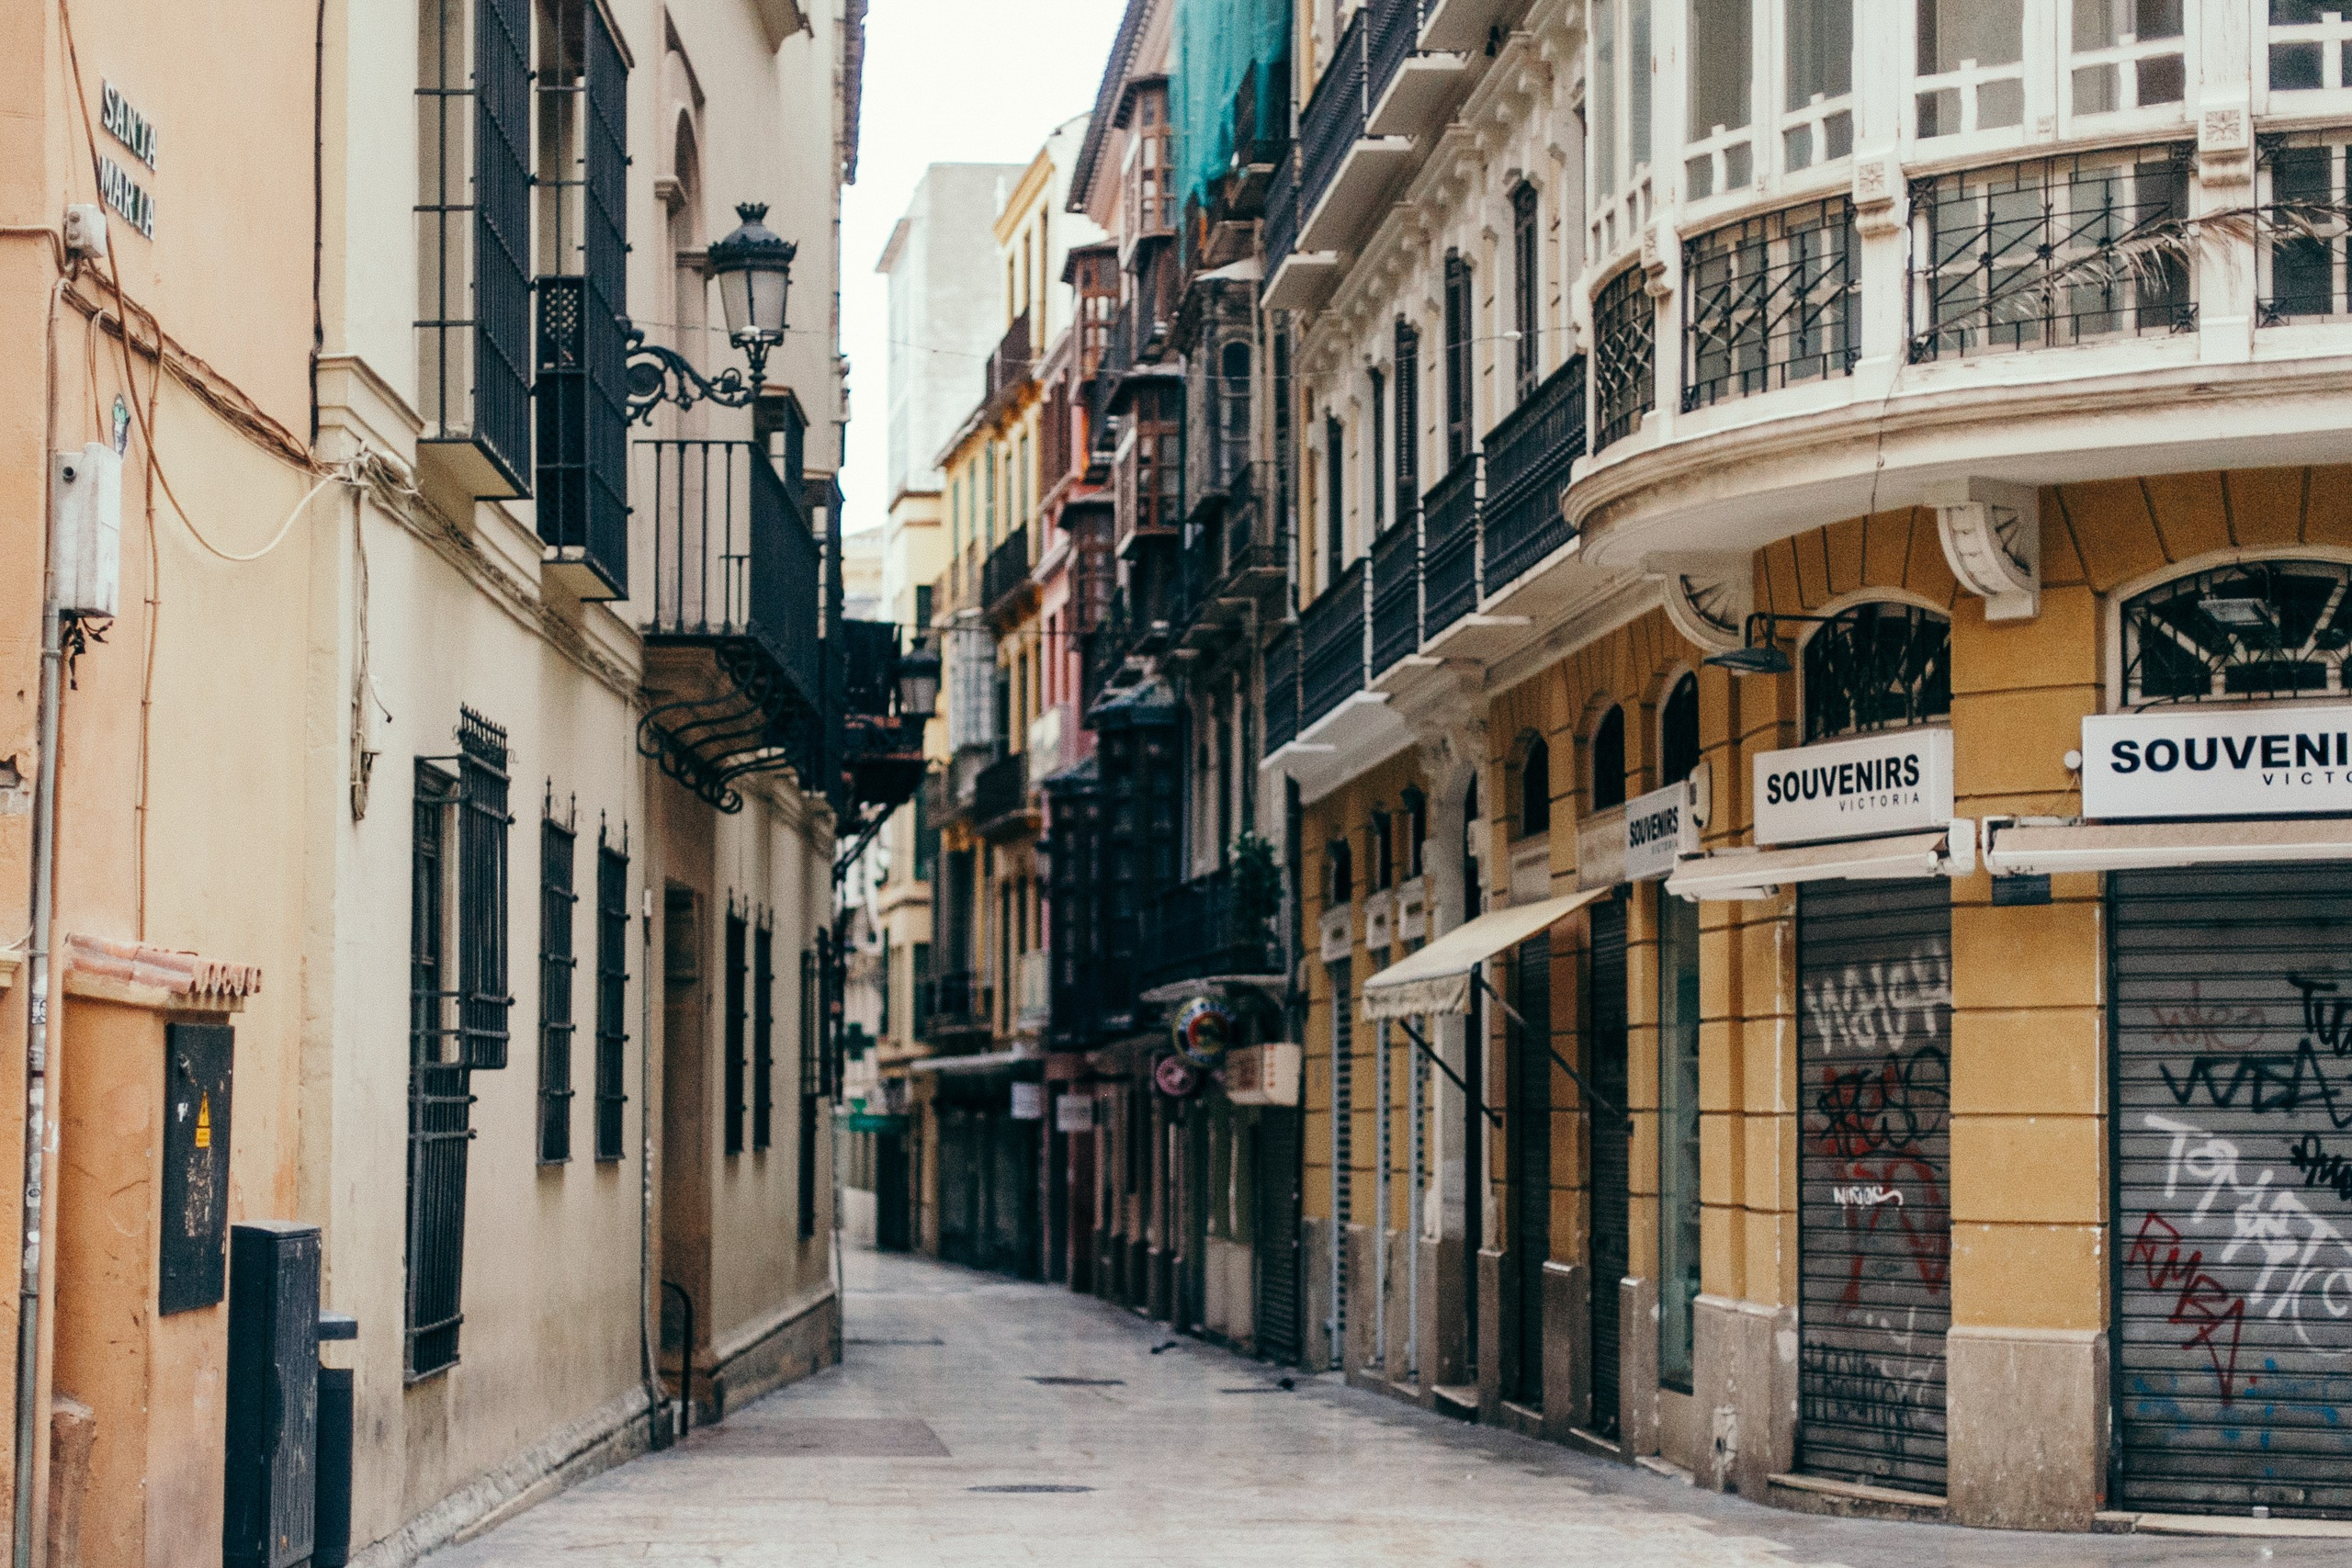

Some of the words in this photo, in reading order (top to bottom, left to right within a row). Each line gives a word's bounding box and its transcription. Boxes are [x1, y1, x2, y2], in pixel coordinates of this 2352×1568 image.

[103, 80, 156, 172] SANTA
[2110, 732, 2348, 773] SOUVENI
[1767, 754, 1919, 805] SOUVENIRS
[1839, 792, 1919, 812] VICTORIA
[1630, 806, 1679, 849] SOUVENIRS
